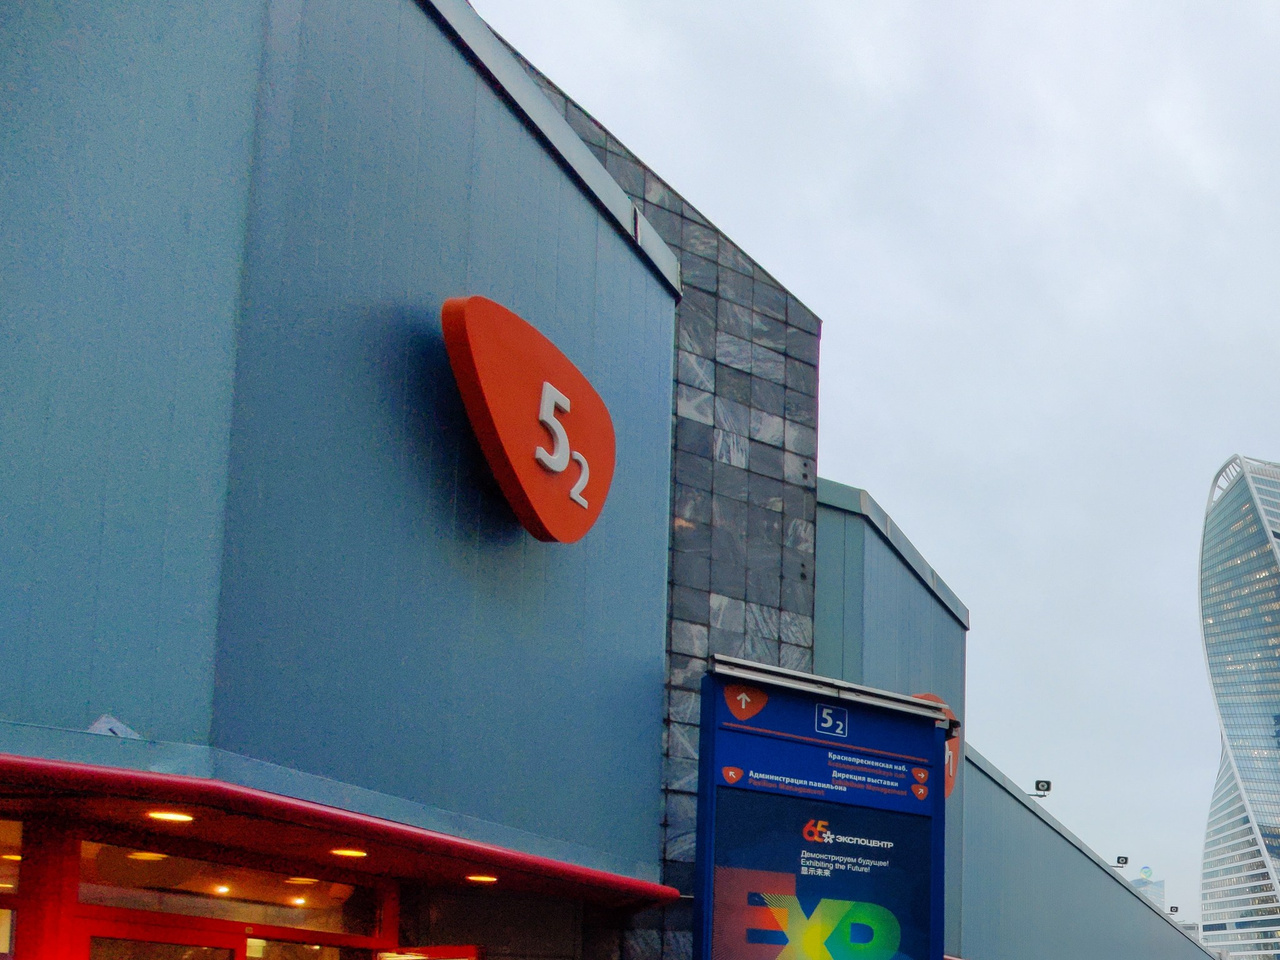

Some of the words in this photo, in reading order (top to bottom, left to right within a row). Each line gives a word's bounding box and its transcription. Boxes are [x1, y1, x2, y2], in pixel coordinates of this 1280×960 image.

[828, 751, 893, 769] Краснопресненская
[894, 763, 908, 772] наб.
[749, 770, 807, 785] Администрация
[808, 780, 847, 792] павильона
[832, 770, 866, 782] Дирекция
[867, 775, 899, 787] выставки
[835, 835, 894, 848] ЭКСПОЦЕНТР
[801, 850, 857, 863] Демонстрируем
[857, 857, 889, 867] будущее!
[801, 858, 834, 870] Exhibiting
[847, 864, 870, 873] Future!
[801, 866, 831, 877] 显示未来
